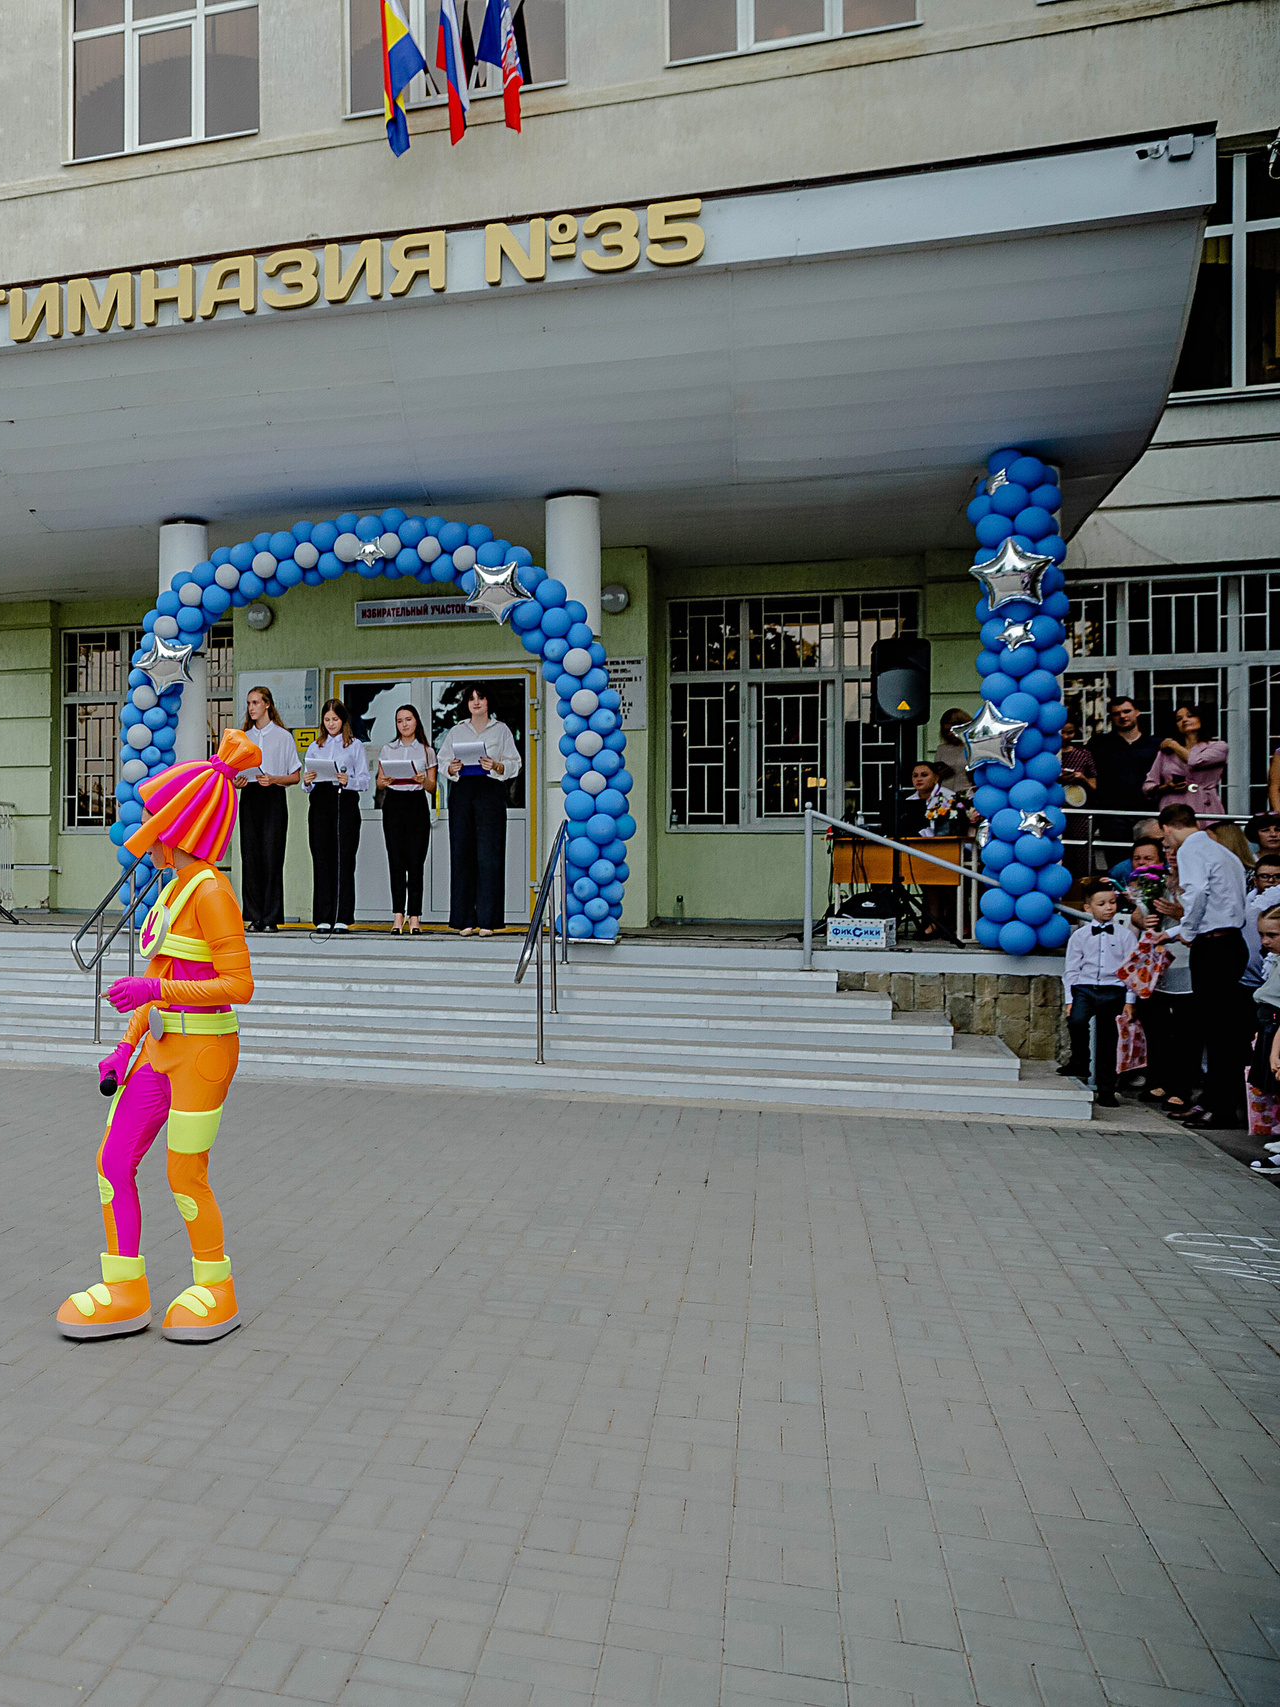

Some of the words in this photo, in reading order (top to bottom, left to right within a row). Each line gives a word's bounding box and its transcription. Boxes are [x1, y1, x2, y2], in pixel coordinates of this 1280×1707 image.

[484, 198, 706, 285] №35
[361, 603, 428, 619] ИЗБИРАТЕЛЬНЫЙ
[431, 603, 466, 615] УЧАСТОК
